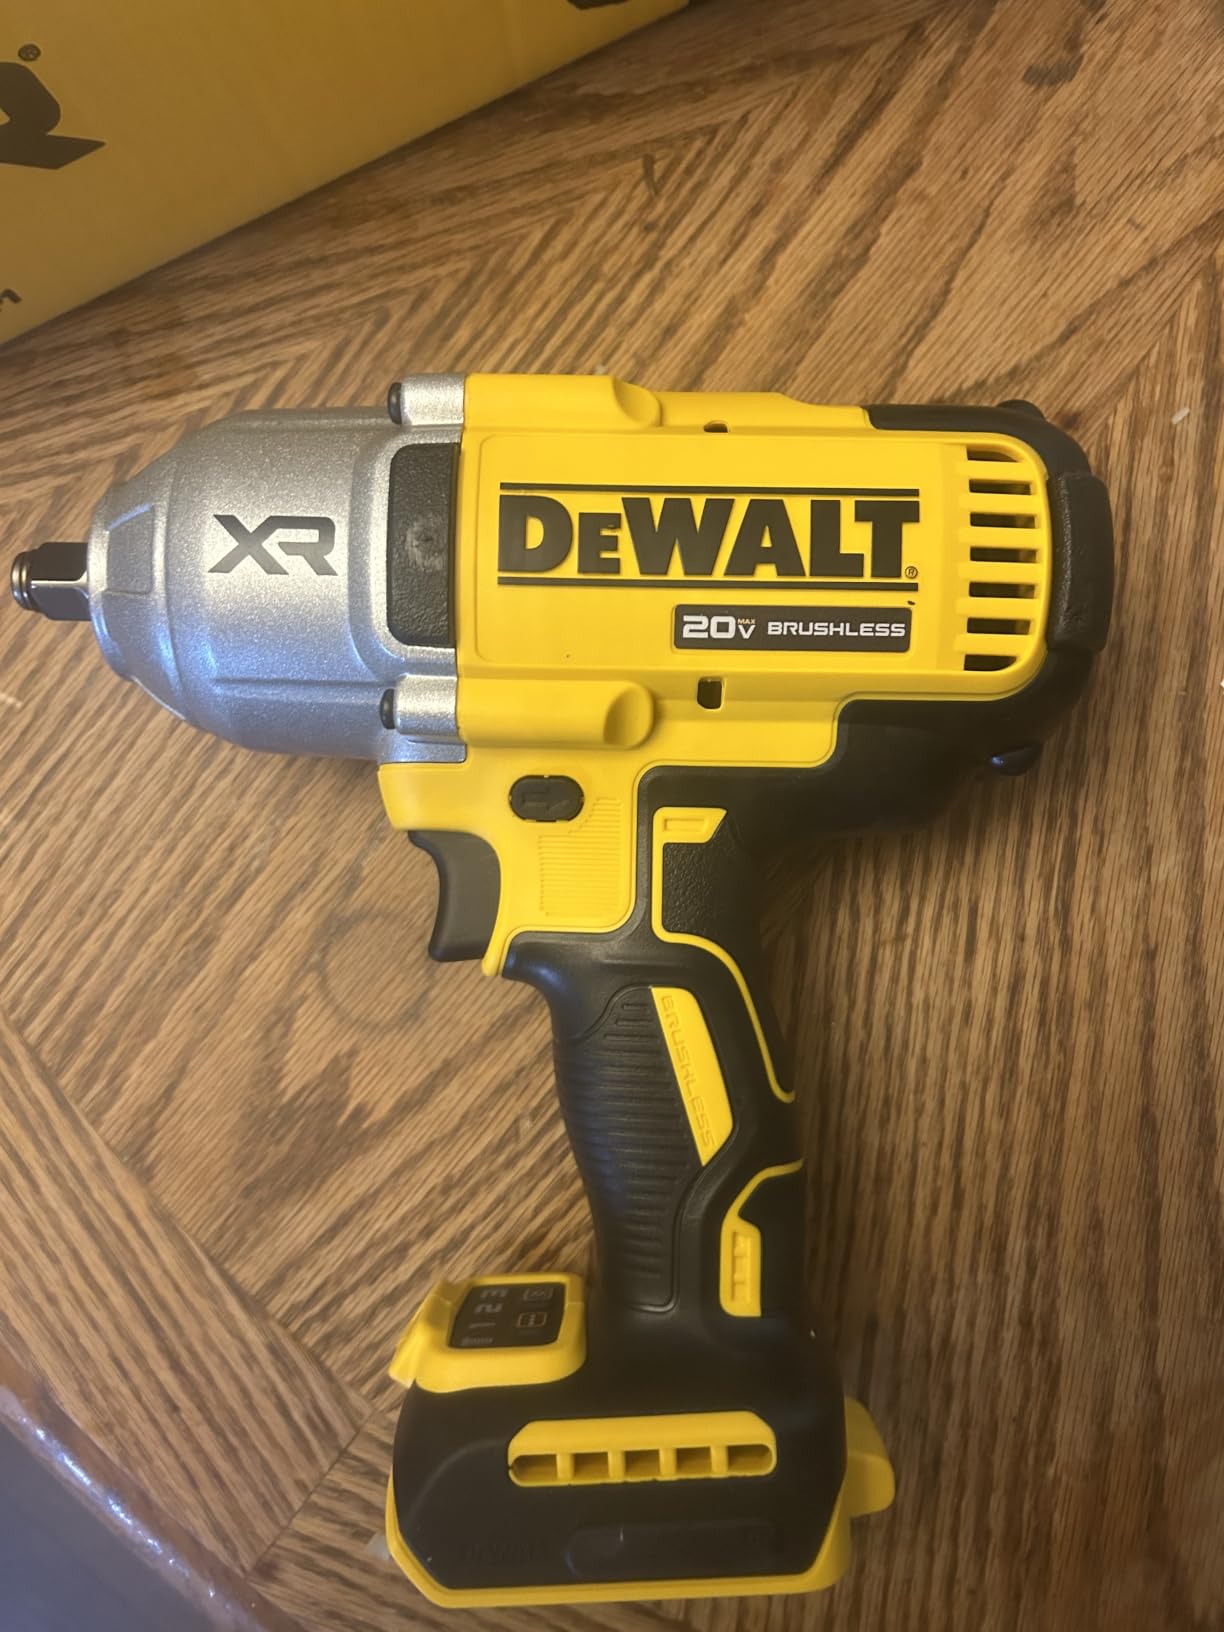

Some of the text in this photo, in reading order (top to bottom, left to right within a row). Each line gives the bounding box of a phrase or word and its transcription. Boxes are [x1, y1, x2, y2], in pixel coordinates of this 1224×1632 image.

[208, 514, 338, 576] XR
[767, 621, 906, 637] BRUSHLESS
[661, 995, 715, 1147] BRUSHLESS
